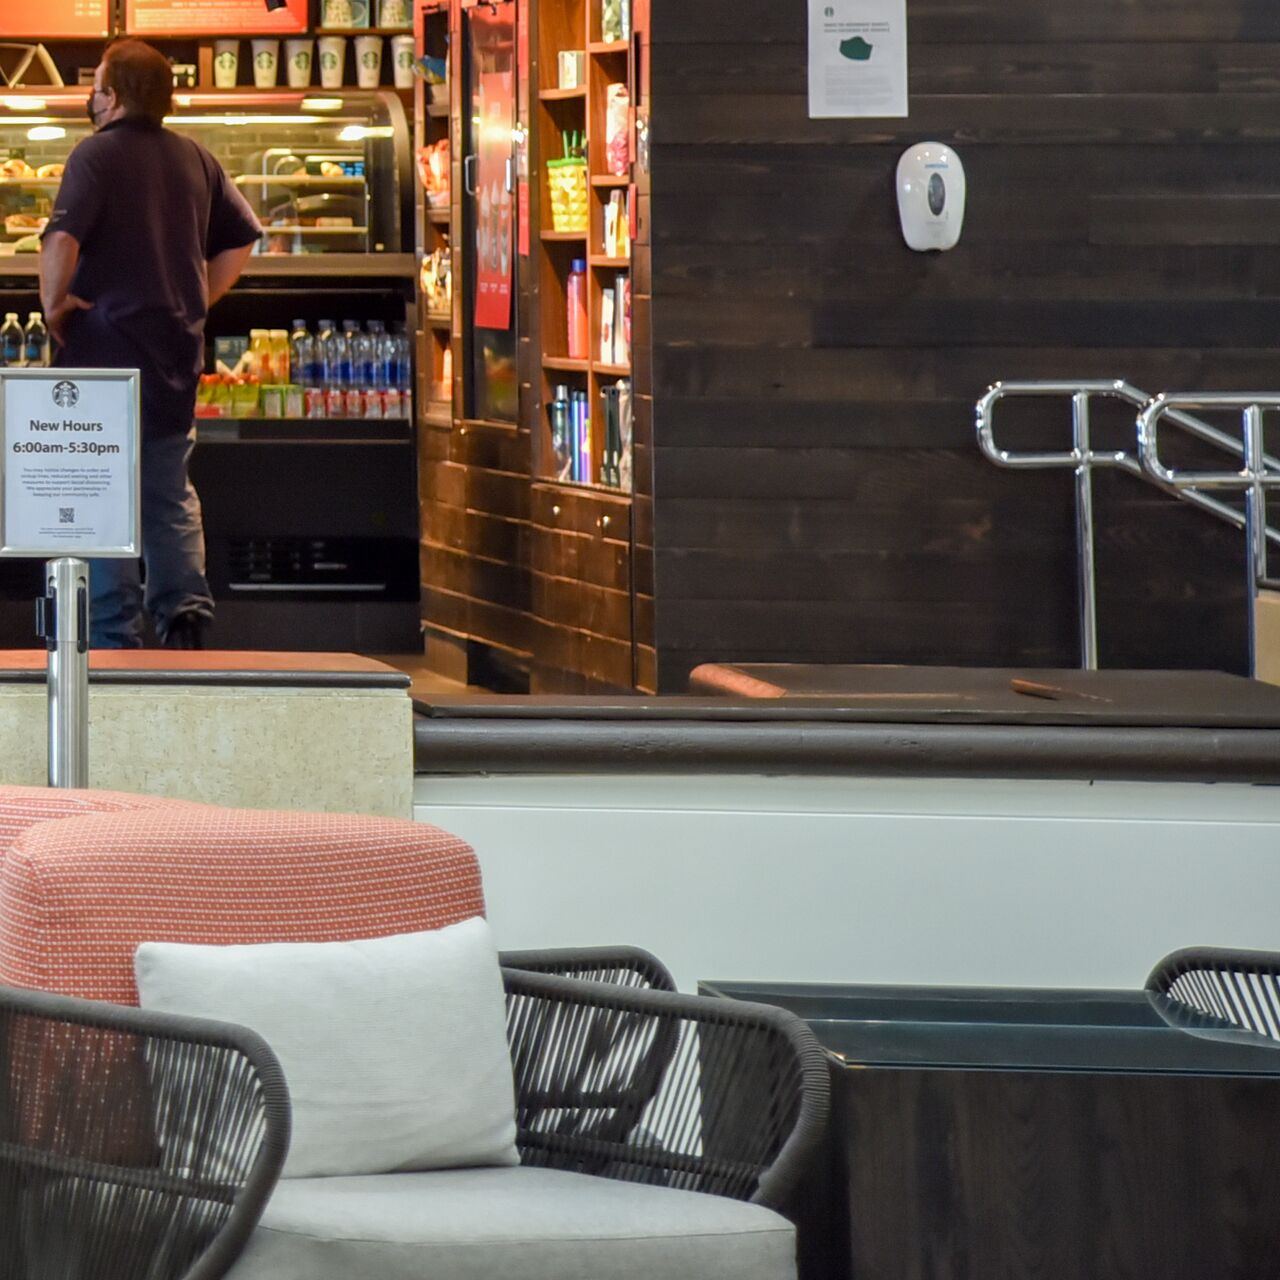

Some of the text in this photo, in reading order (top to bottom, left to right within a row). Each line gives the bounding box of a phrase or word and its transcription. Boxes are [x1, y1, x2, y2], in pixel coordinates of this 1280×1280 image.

[29, 419, 104, 432] New Hours
[12, 441, 120, 456] 6:00am-5:30pm
